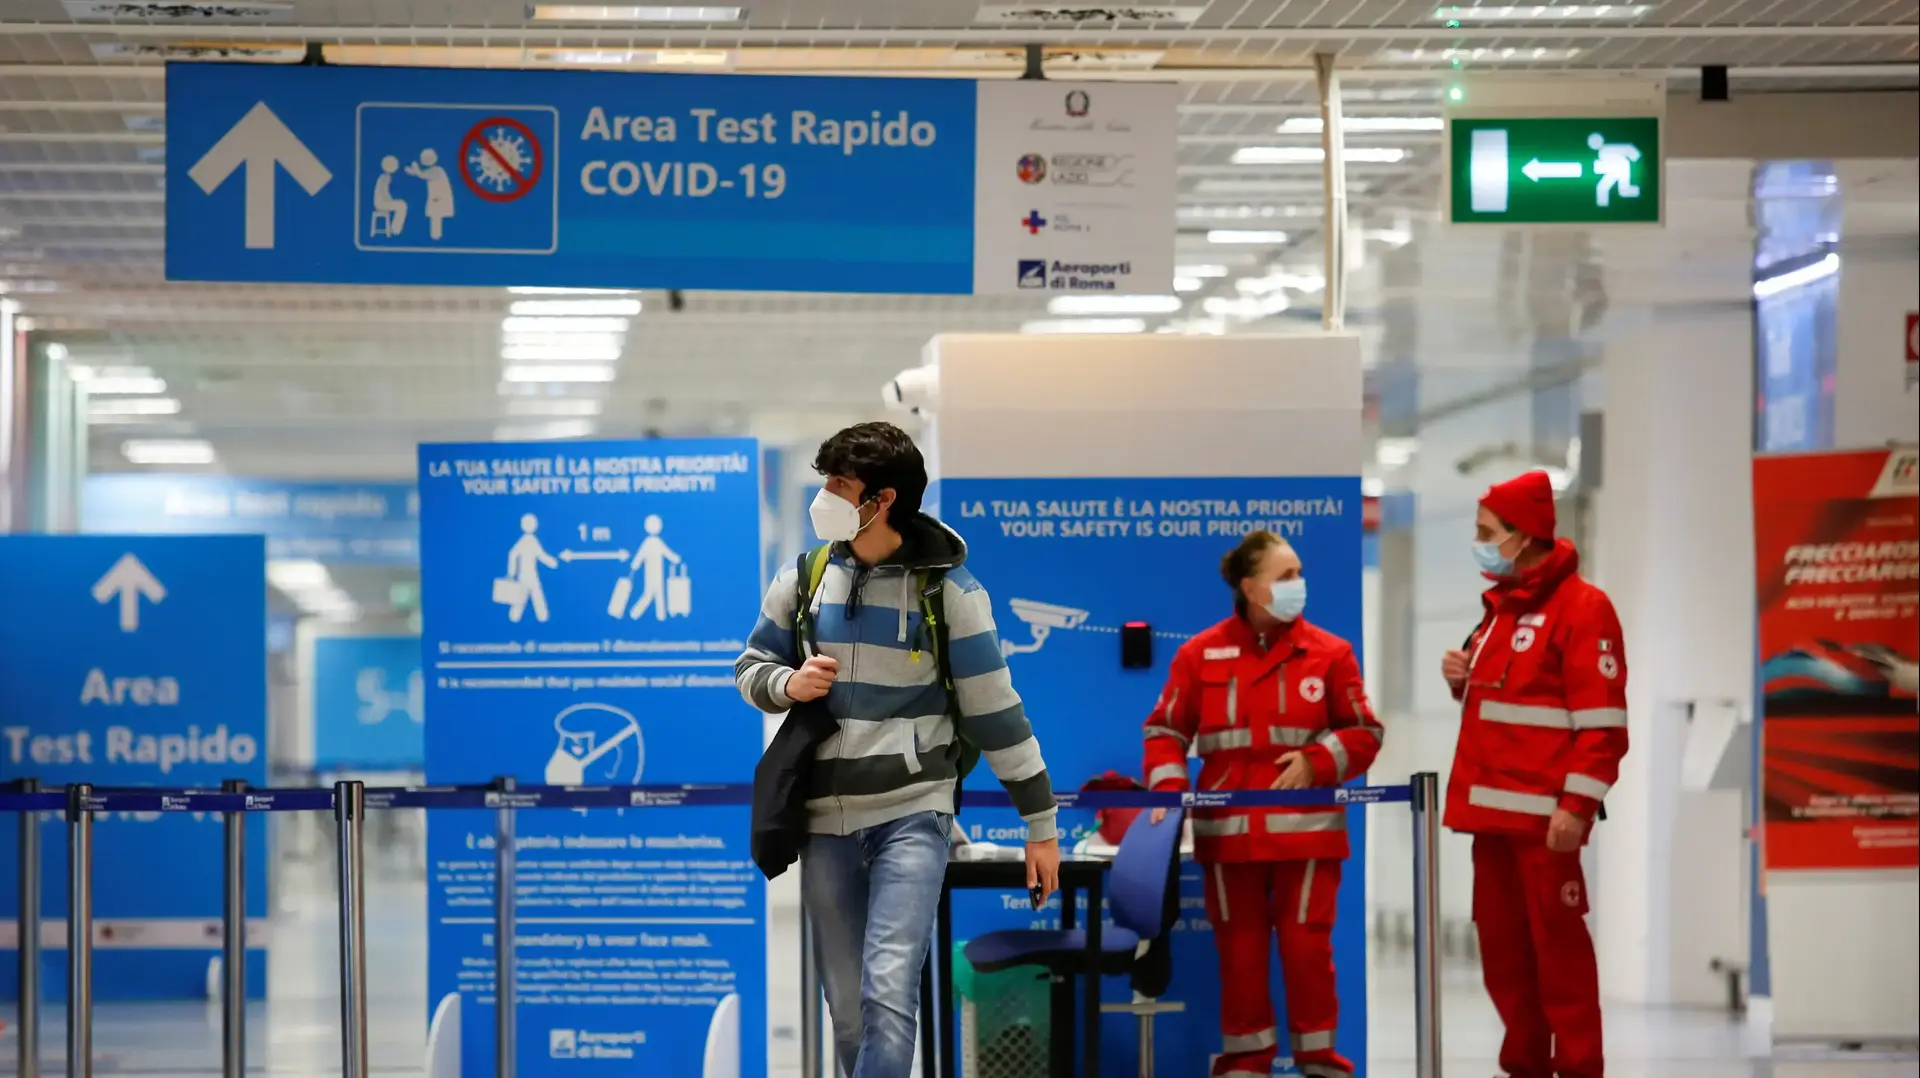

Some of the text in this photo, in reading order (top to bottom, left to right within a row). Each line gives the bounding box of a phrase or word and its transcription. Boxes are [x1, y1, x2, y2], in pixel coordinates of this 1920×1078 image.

[579, 106, 937, 156] Area Test Rapido
[580, 160, 787, 199] COVID-19
[1050, 261, 1131, 277] Aeroporti
[1050, 277, 1116, 290] di Roma
[429, 452, 748, 477] LA TUA SALUTE È LA NOSTRA PRIORITÀ!
[462, 475, 716, 495] YOUR SAFETY IS OUR PRIORITY!
[961, 495, 1343, 518] LA TUA SALUTE È LA NOSTRA PRIORITÀ!
[578, 524, 611, 541] 1 m
[1000, 520, 1303, 538] YOUR SAFETY IS OUR PRIORITY!
[79, 668, 181, 706] Area
[4, 723, 258, 774] Test Rapido
